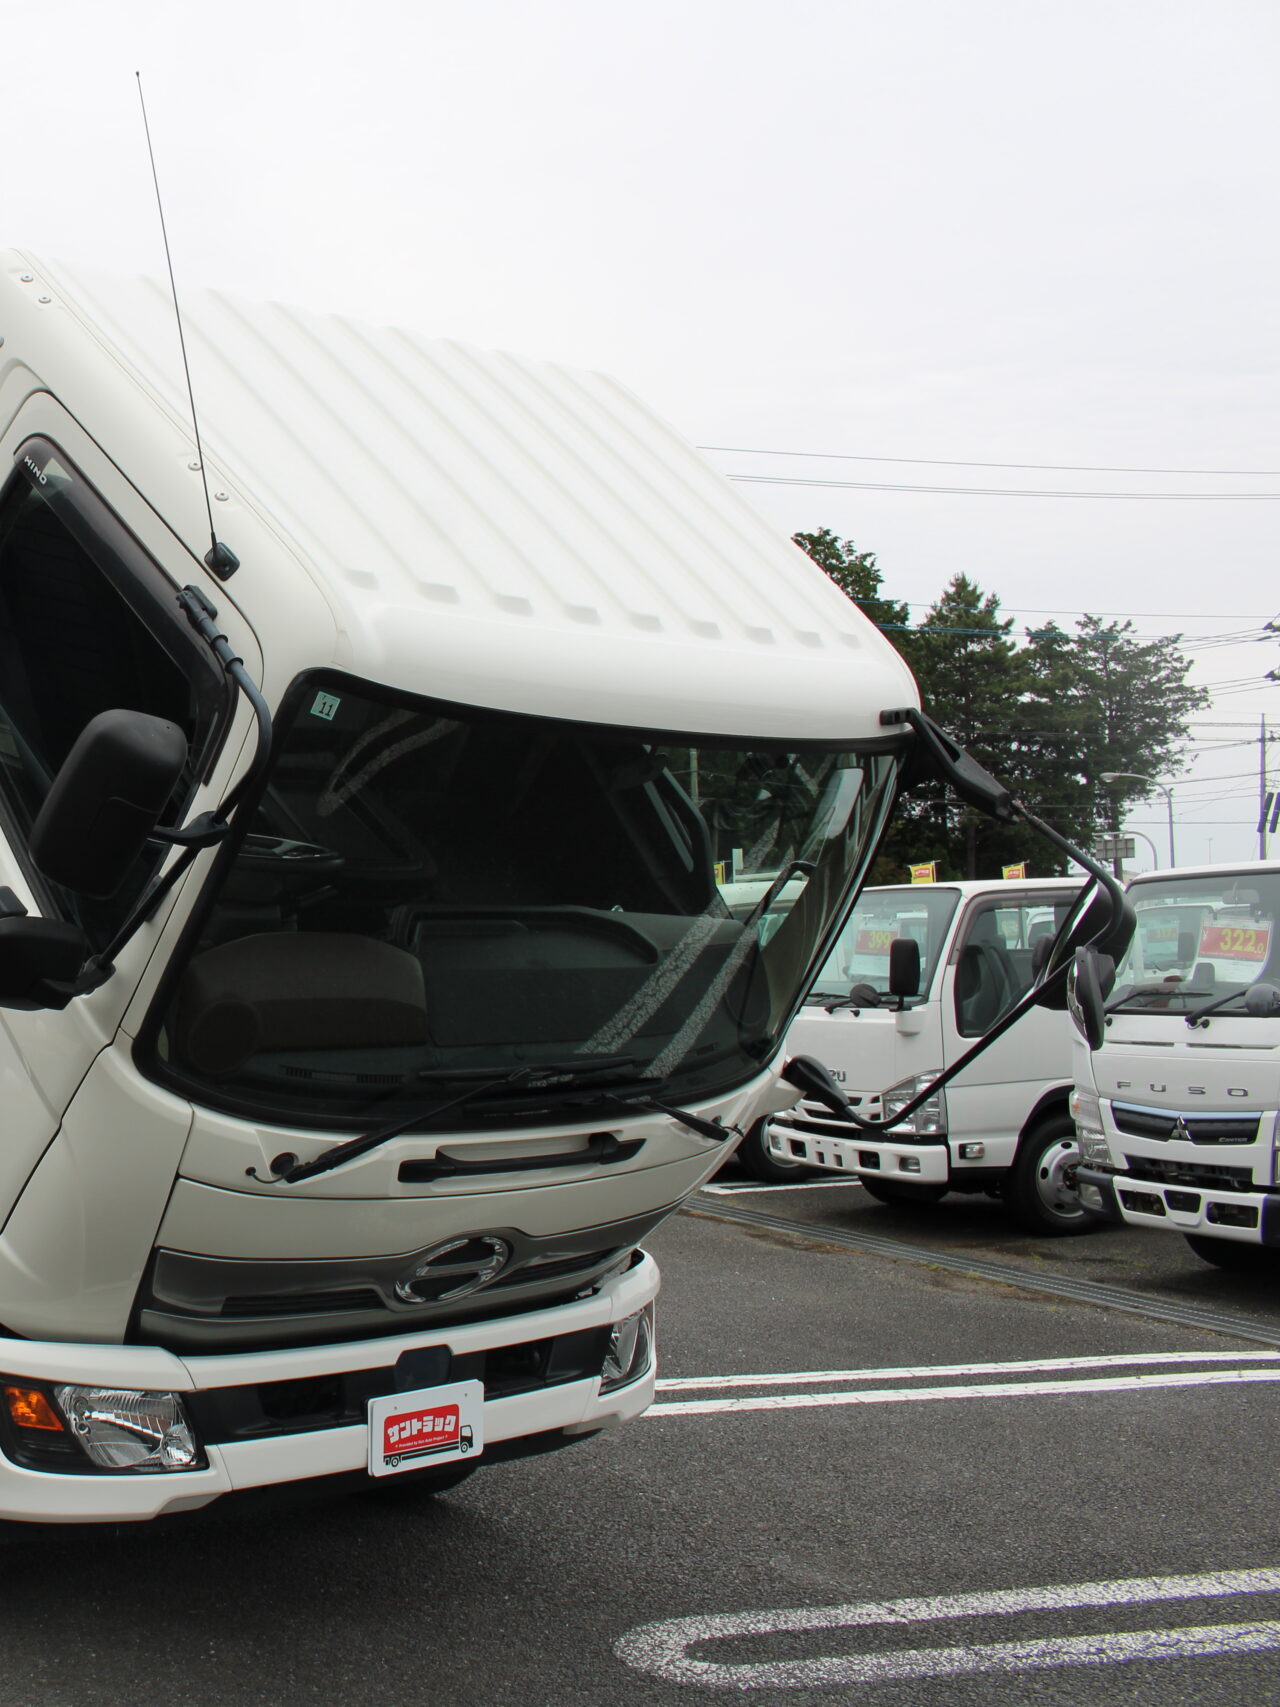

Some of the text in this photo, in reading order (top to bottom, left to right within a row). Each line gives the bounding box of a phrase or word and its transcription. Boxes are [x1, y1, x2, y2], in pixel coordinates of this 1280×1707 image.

[24, 455, 47, 485] HINO
[318, 701, 334, 717] 11
[1116, 1080, 1249, 1098] FUSO
[387, 1414, 457, 1444] サントラック
